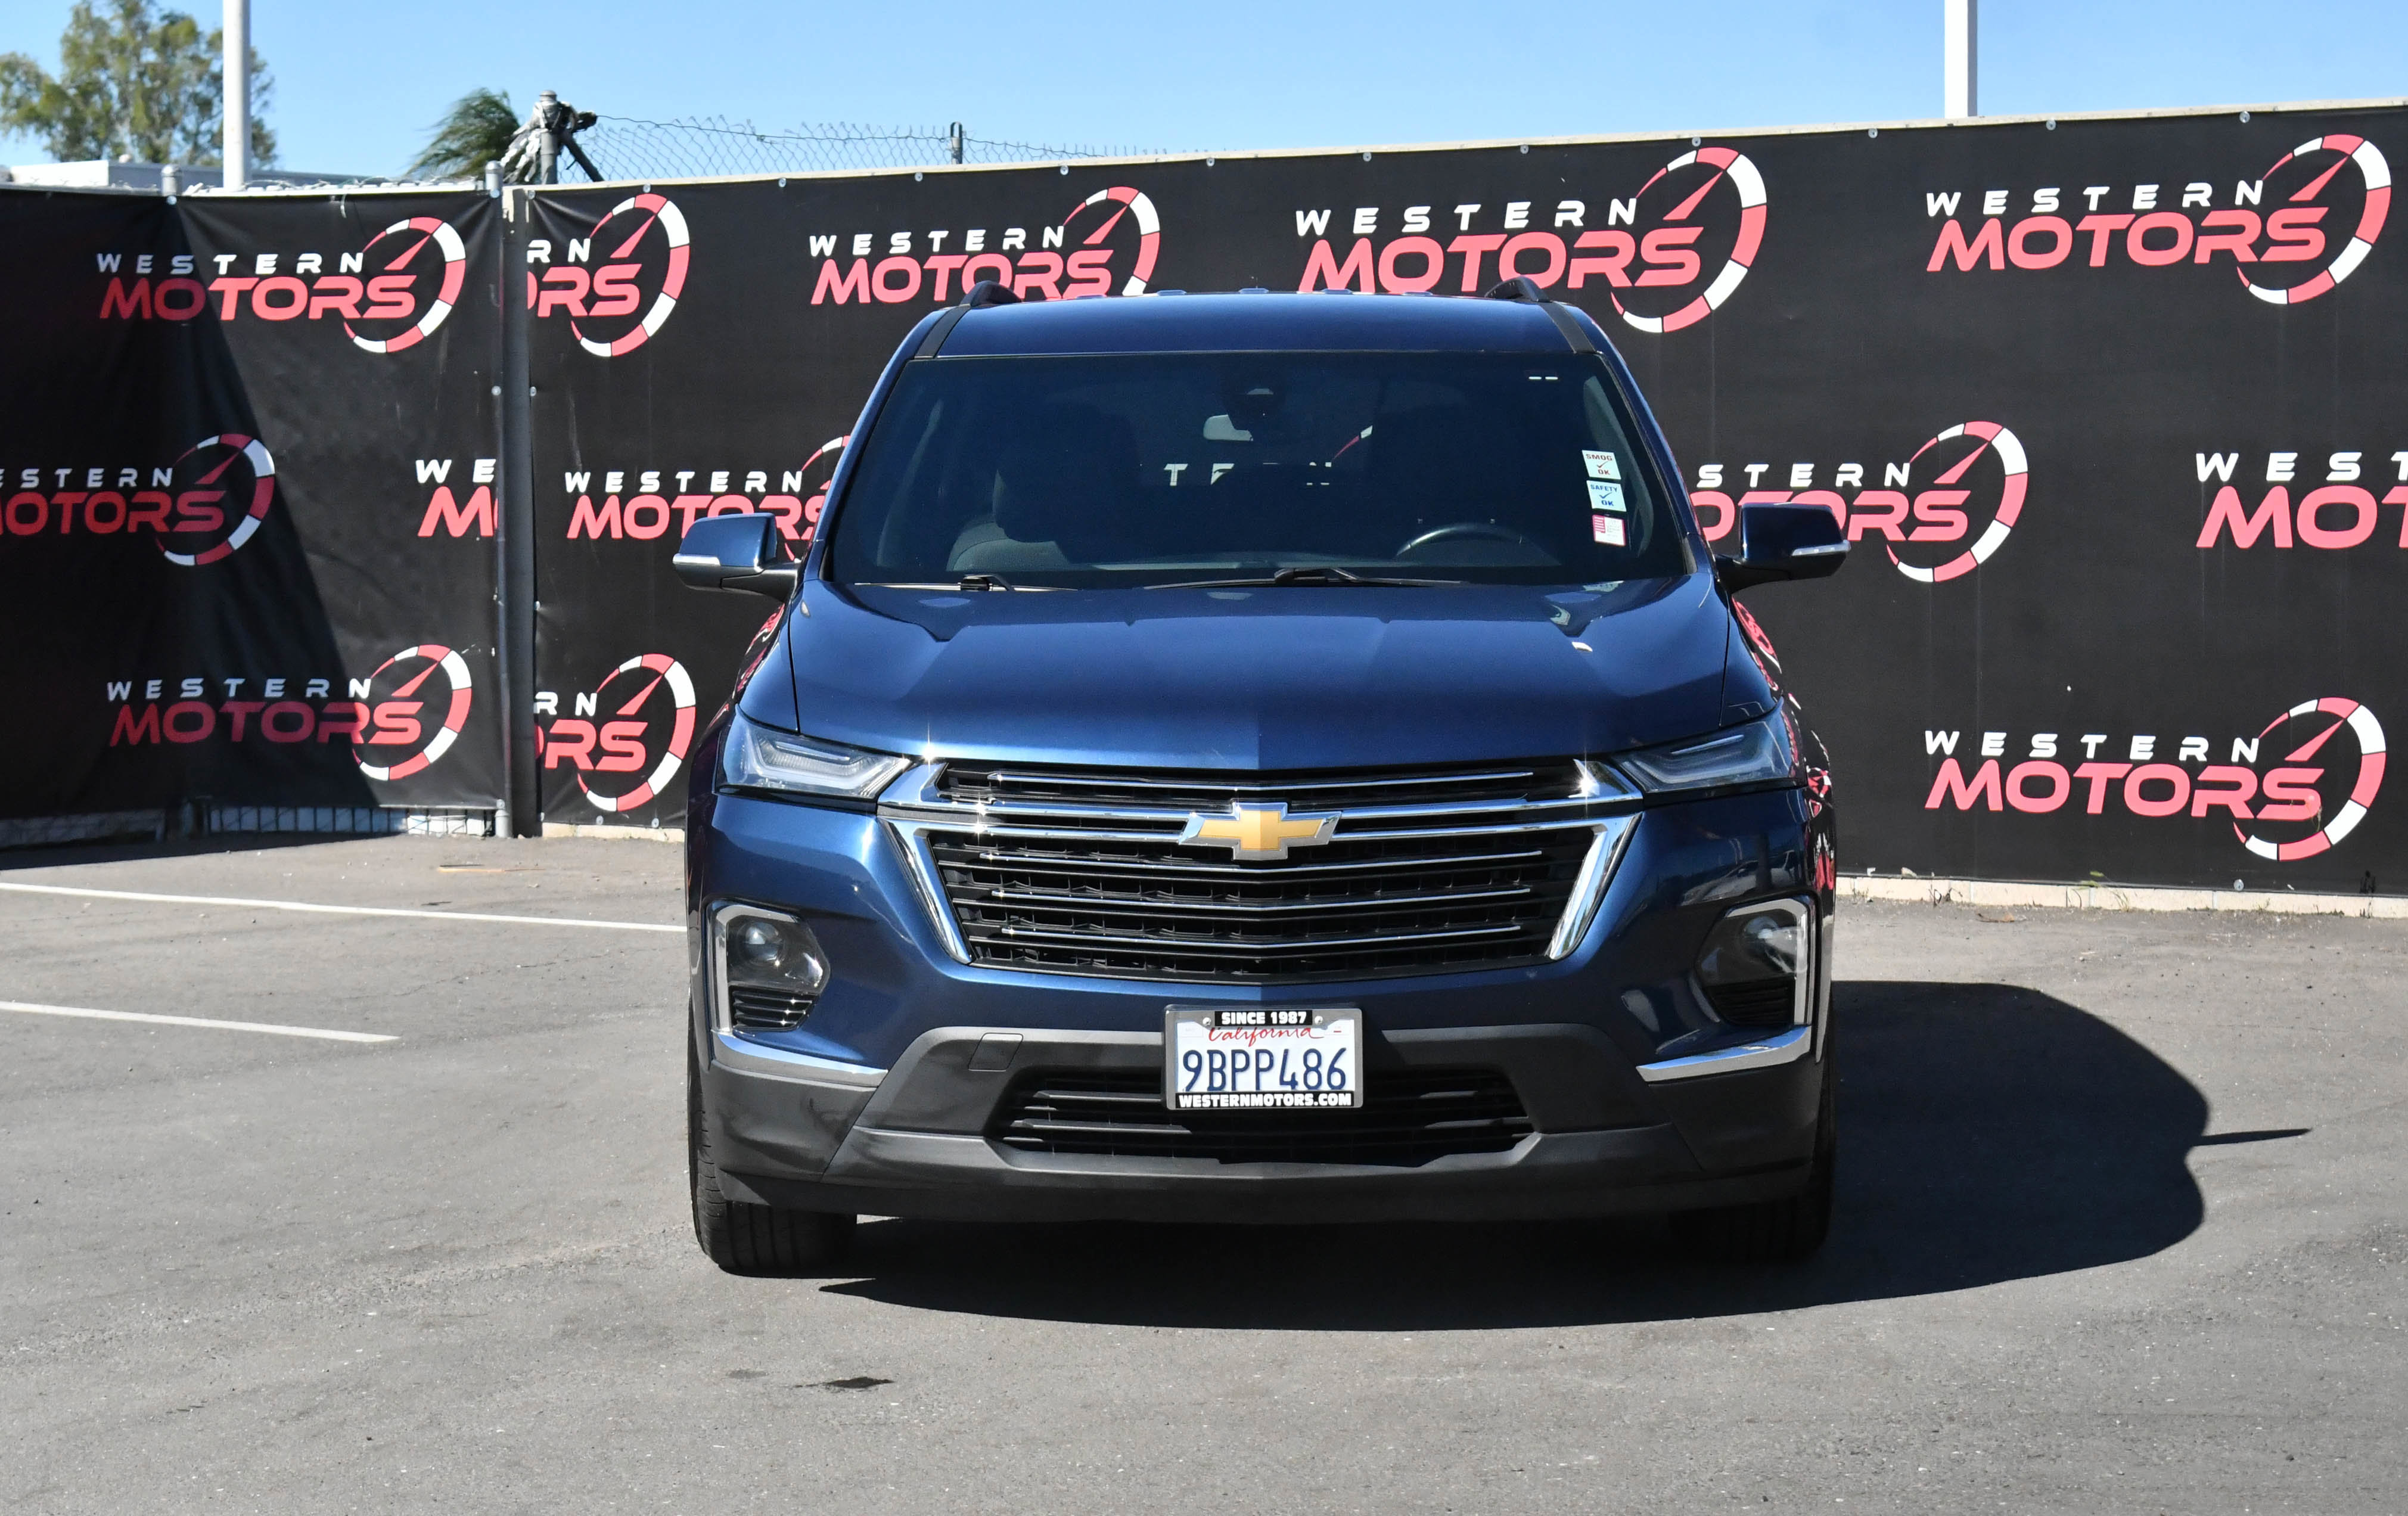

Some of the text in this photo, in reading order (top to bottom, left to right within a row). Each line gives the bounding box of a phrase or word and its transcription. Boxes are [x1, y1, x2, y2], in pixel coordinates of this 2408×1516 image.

[1296, 198, 1636, 236] WESTERN
[1927, 180, 2263, 217] WESTERN
[810, 226, 1064, 257] WESTERN
[1927, 207, 2329, 271] MOTORS
[98, 253, 362, 275] WESTERN
[810, 249, 1114, 305] MOTORS
[1299, 226, 1703, 293] MOTORS
[100, 275, 417, 321] MOTORS
[527, 266, 642, 317] RS
[0, 468, 172, 487] STERN
[565, 469, 803, 493] WESTERN
[1590, 484, 1617, 492] SAFETY
[1697, 462, 1910, 487] STERN
[0, 491, 223, 536] OTORS
[108, 678, 371, 701] WESTERN
[111, 701, 424, 746] MOTORS
[534, 719, 648, 771] RS
[1925, 731, 2259, 763] WESTERN
[1925, 759, 2324, 820] MOTORS
[1222, 1012, 1307, 1024] SINCE 1987
[1208, 1027, 1324, 1047] California
[1183, 1048, 1347, 1092] 9BPP486
[1179, 1093, 1351, 1107] WESTERNMOTORS.COM
